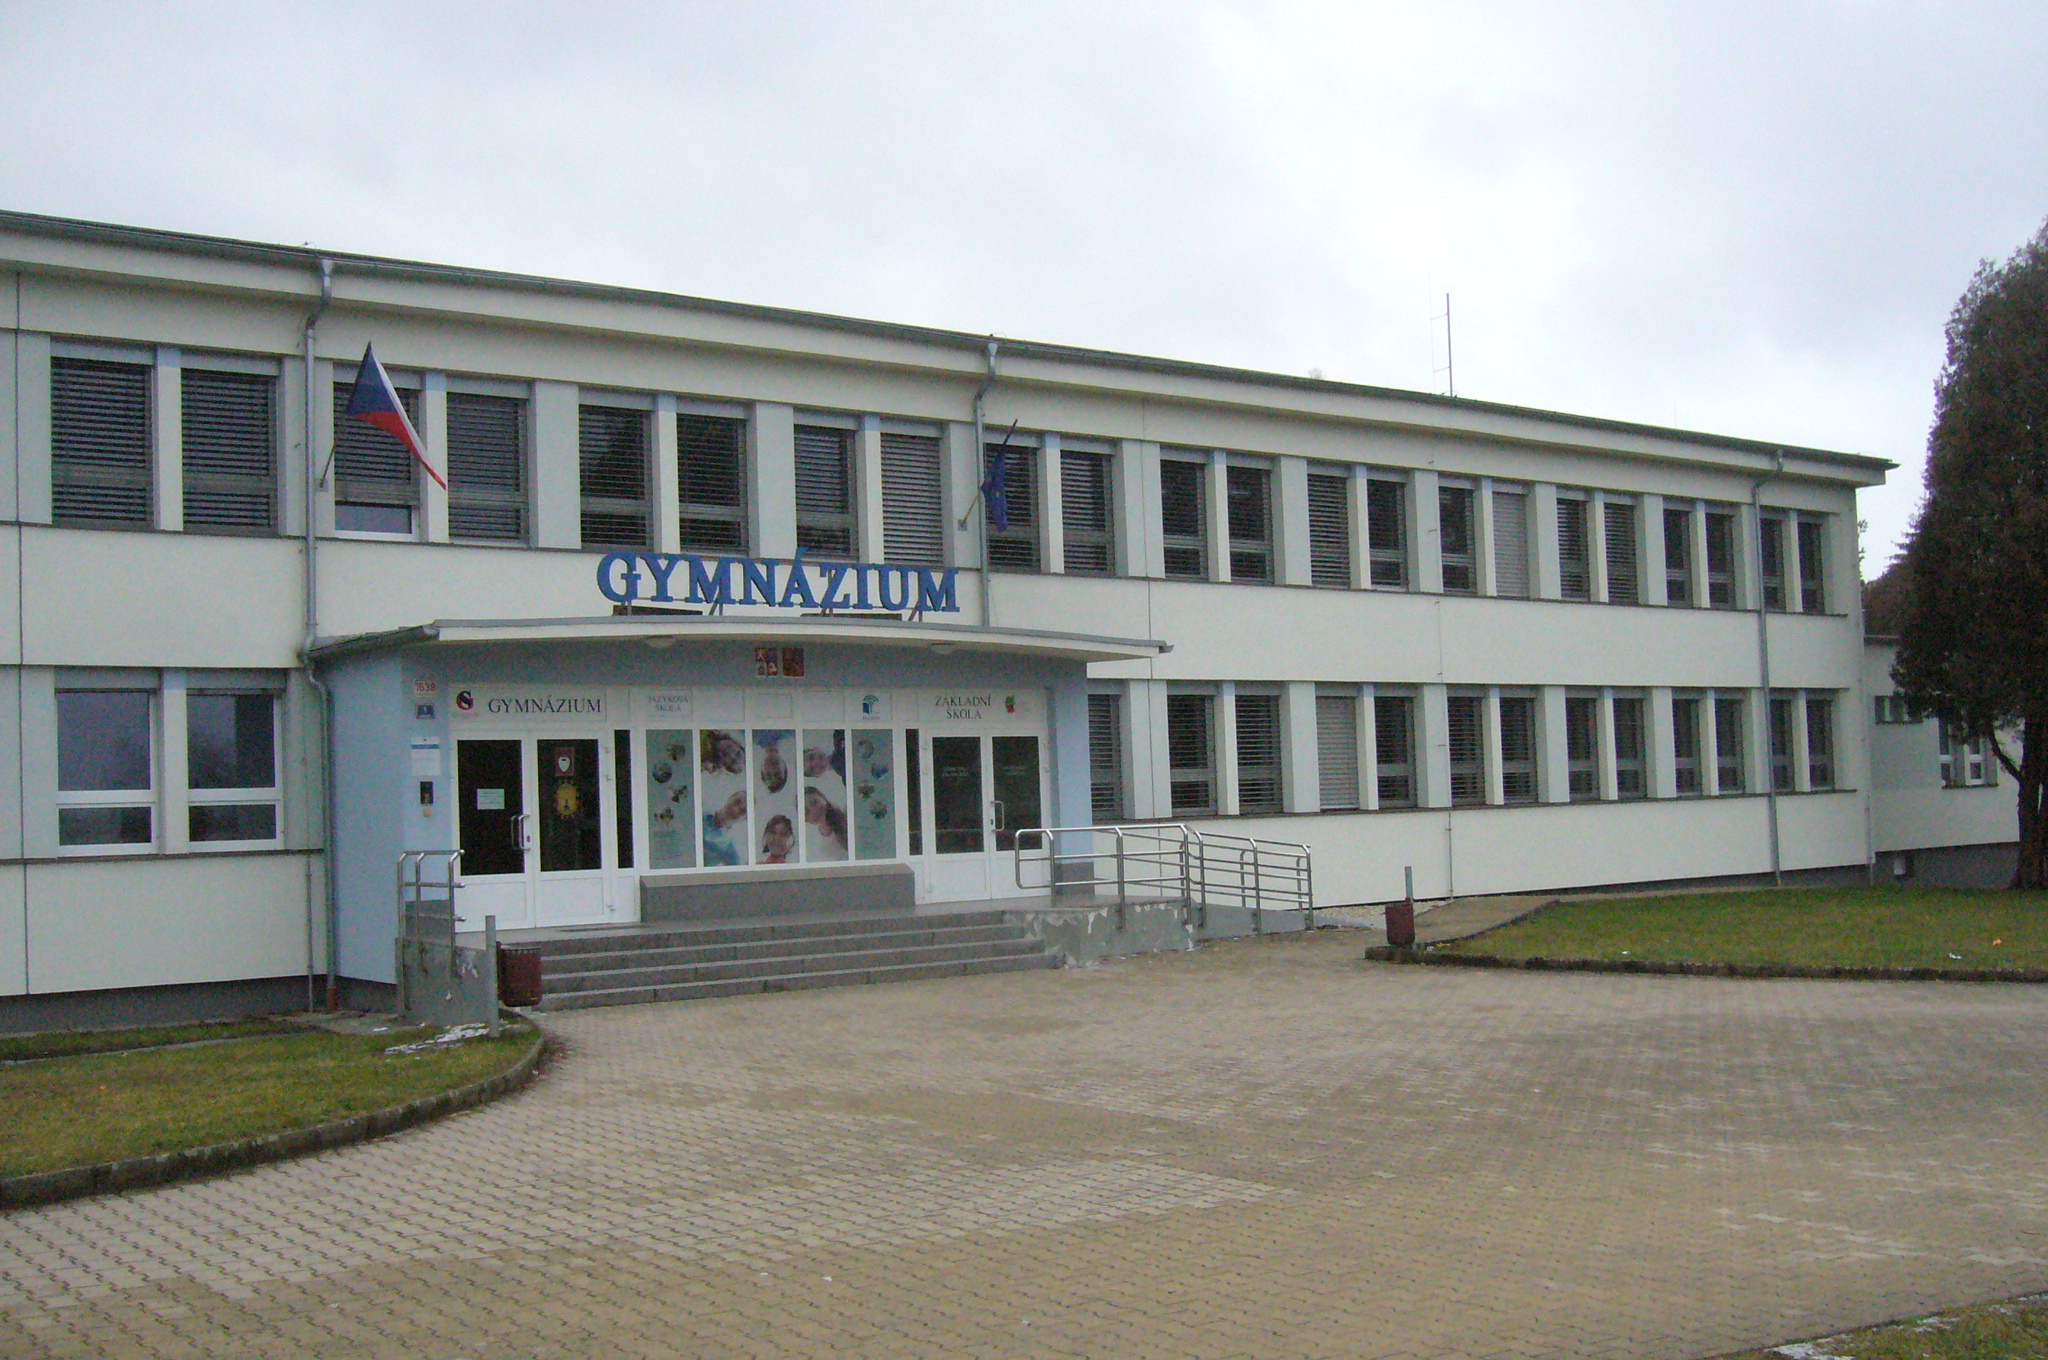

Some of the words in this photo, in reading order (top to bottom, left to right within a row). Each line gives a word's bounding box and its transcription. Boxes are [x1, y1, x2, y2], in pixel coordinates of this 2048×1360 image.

[597, 546, 960, 613] GYMNÁZIUM
[488, 694, 602, 714] GYMNÁZIUM
[934, 693, 992, 707] ZÁKLADNÍ
[946, 707, 982, 719] ŠKOLA
